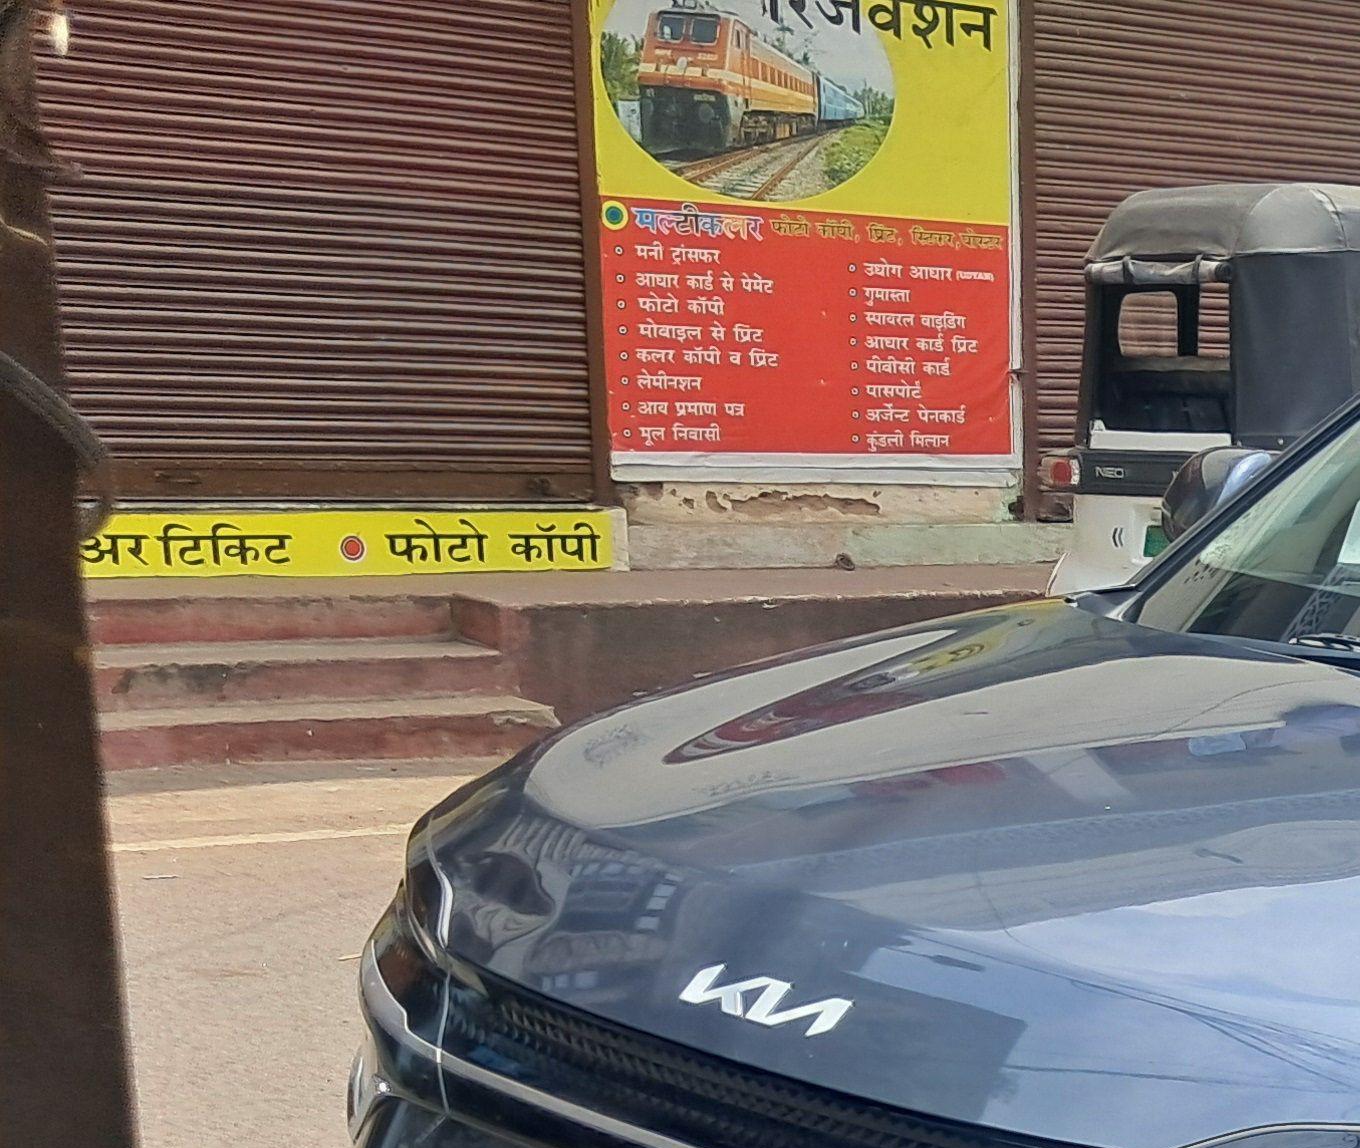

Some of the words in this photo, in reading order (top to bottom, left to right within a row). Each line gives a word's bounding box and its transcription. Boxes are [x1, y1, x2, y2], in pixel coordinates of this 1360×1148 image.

[631, 203, 764, 242] मल्टीकलर
[635, 241, 663, 260] मनी
[671, 244, 720, 265] ट्रांसफर
[686, 270, 714, 291] कार्ड
[720, 271, 734, 292] से
[638, 292, 680, 313] फोटो
[687, 295, 725, 316] कॉपी
[863, 287, 911, 307] गुमास्ता
[710, 320, 725, 341] से
[916, 333, 945, 352] कार्ड
[636, 348, 676, 363] कलर
[683, 345, 721, 365] कॉपी
[922, 357, 950, 376] कार्ड
[865, 379, 922, 399] पासपोर्ट
[675, 401, 717, 417] प्रमाण
[724, 402, 746, 417] पत्र
[917, 404, 967, 424] पेनकार्ड
[638, 427, 666, 447] मूल
[672, 422, 722, 442] निवासी
[1095, 466, 1125, 479] NEO
[154, 523, 293, 566] टिकिट
[386, 518, 489, 564] फोटो
[508, 522, 600, 564] कॉपी
[679, 961, 856, 1038] KIA
